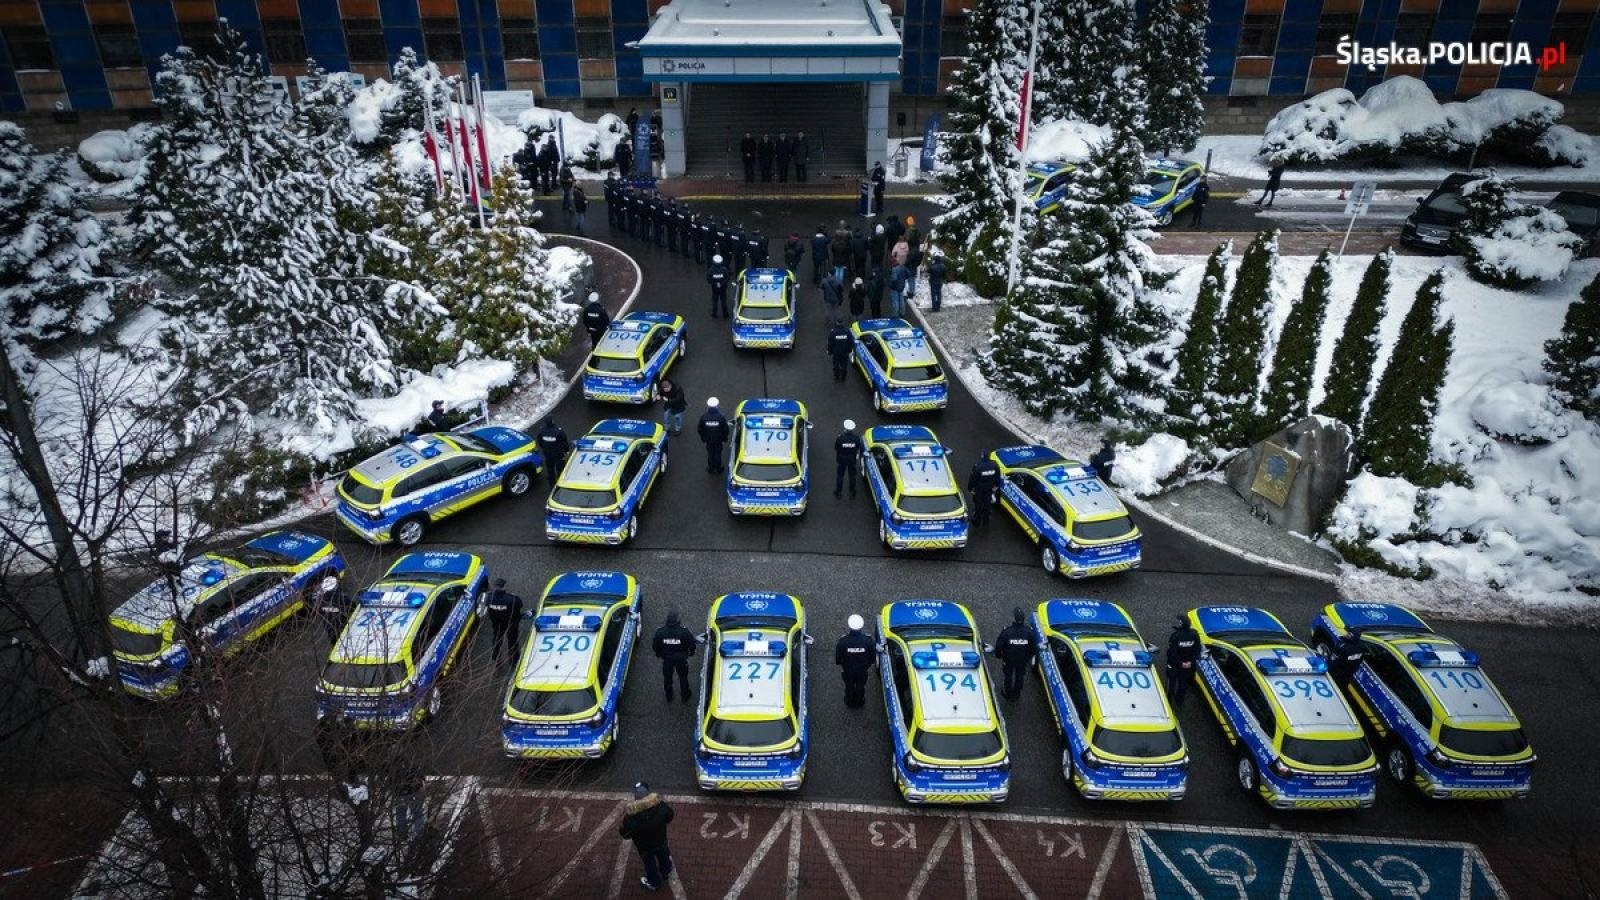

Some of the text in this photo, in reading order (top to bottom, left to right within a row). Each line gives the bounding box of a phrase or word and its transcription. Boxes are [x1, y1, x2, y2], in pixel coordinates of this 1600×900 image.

[678, 62, 705, 70] POLICJA
[752, 431, 789, 443] 170
[579, 454, 616, 466] 145
[906, 461, 940, 472] 171
[467, 470, 497, 489] POLICJA
[1063, 480, 1102, 498] 133
[357, 611, 411, 627] 24
[539, 635, 592, 653] 520
[728, 662, 781, 681] 227
[1096, 671, 1152, 690] 400
[1431, 671, 1484, 690] 110
[925, 672, 977, 693] 194
[1273, 679, 1335, 699] 398
[700, 811, 751, 839] K2
[867, 820, 918, 849] K3
[1036, 829, 1086, 859] K4
